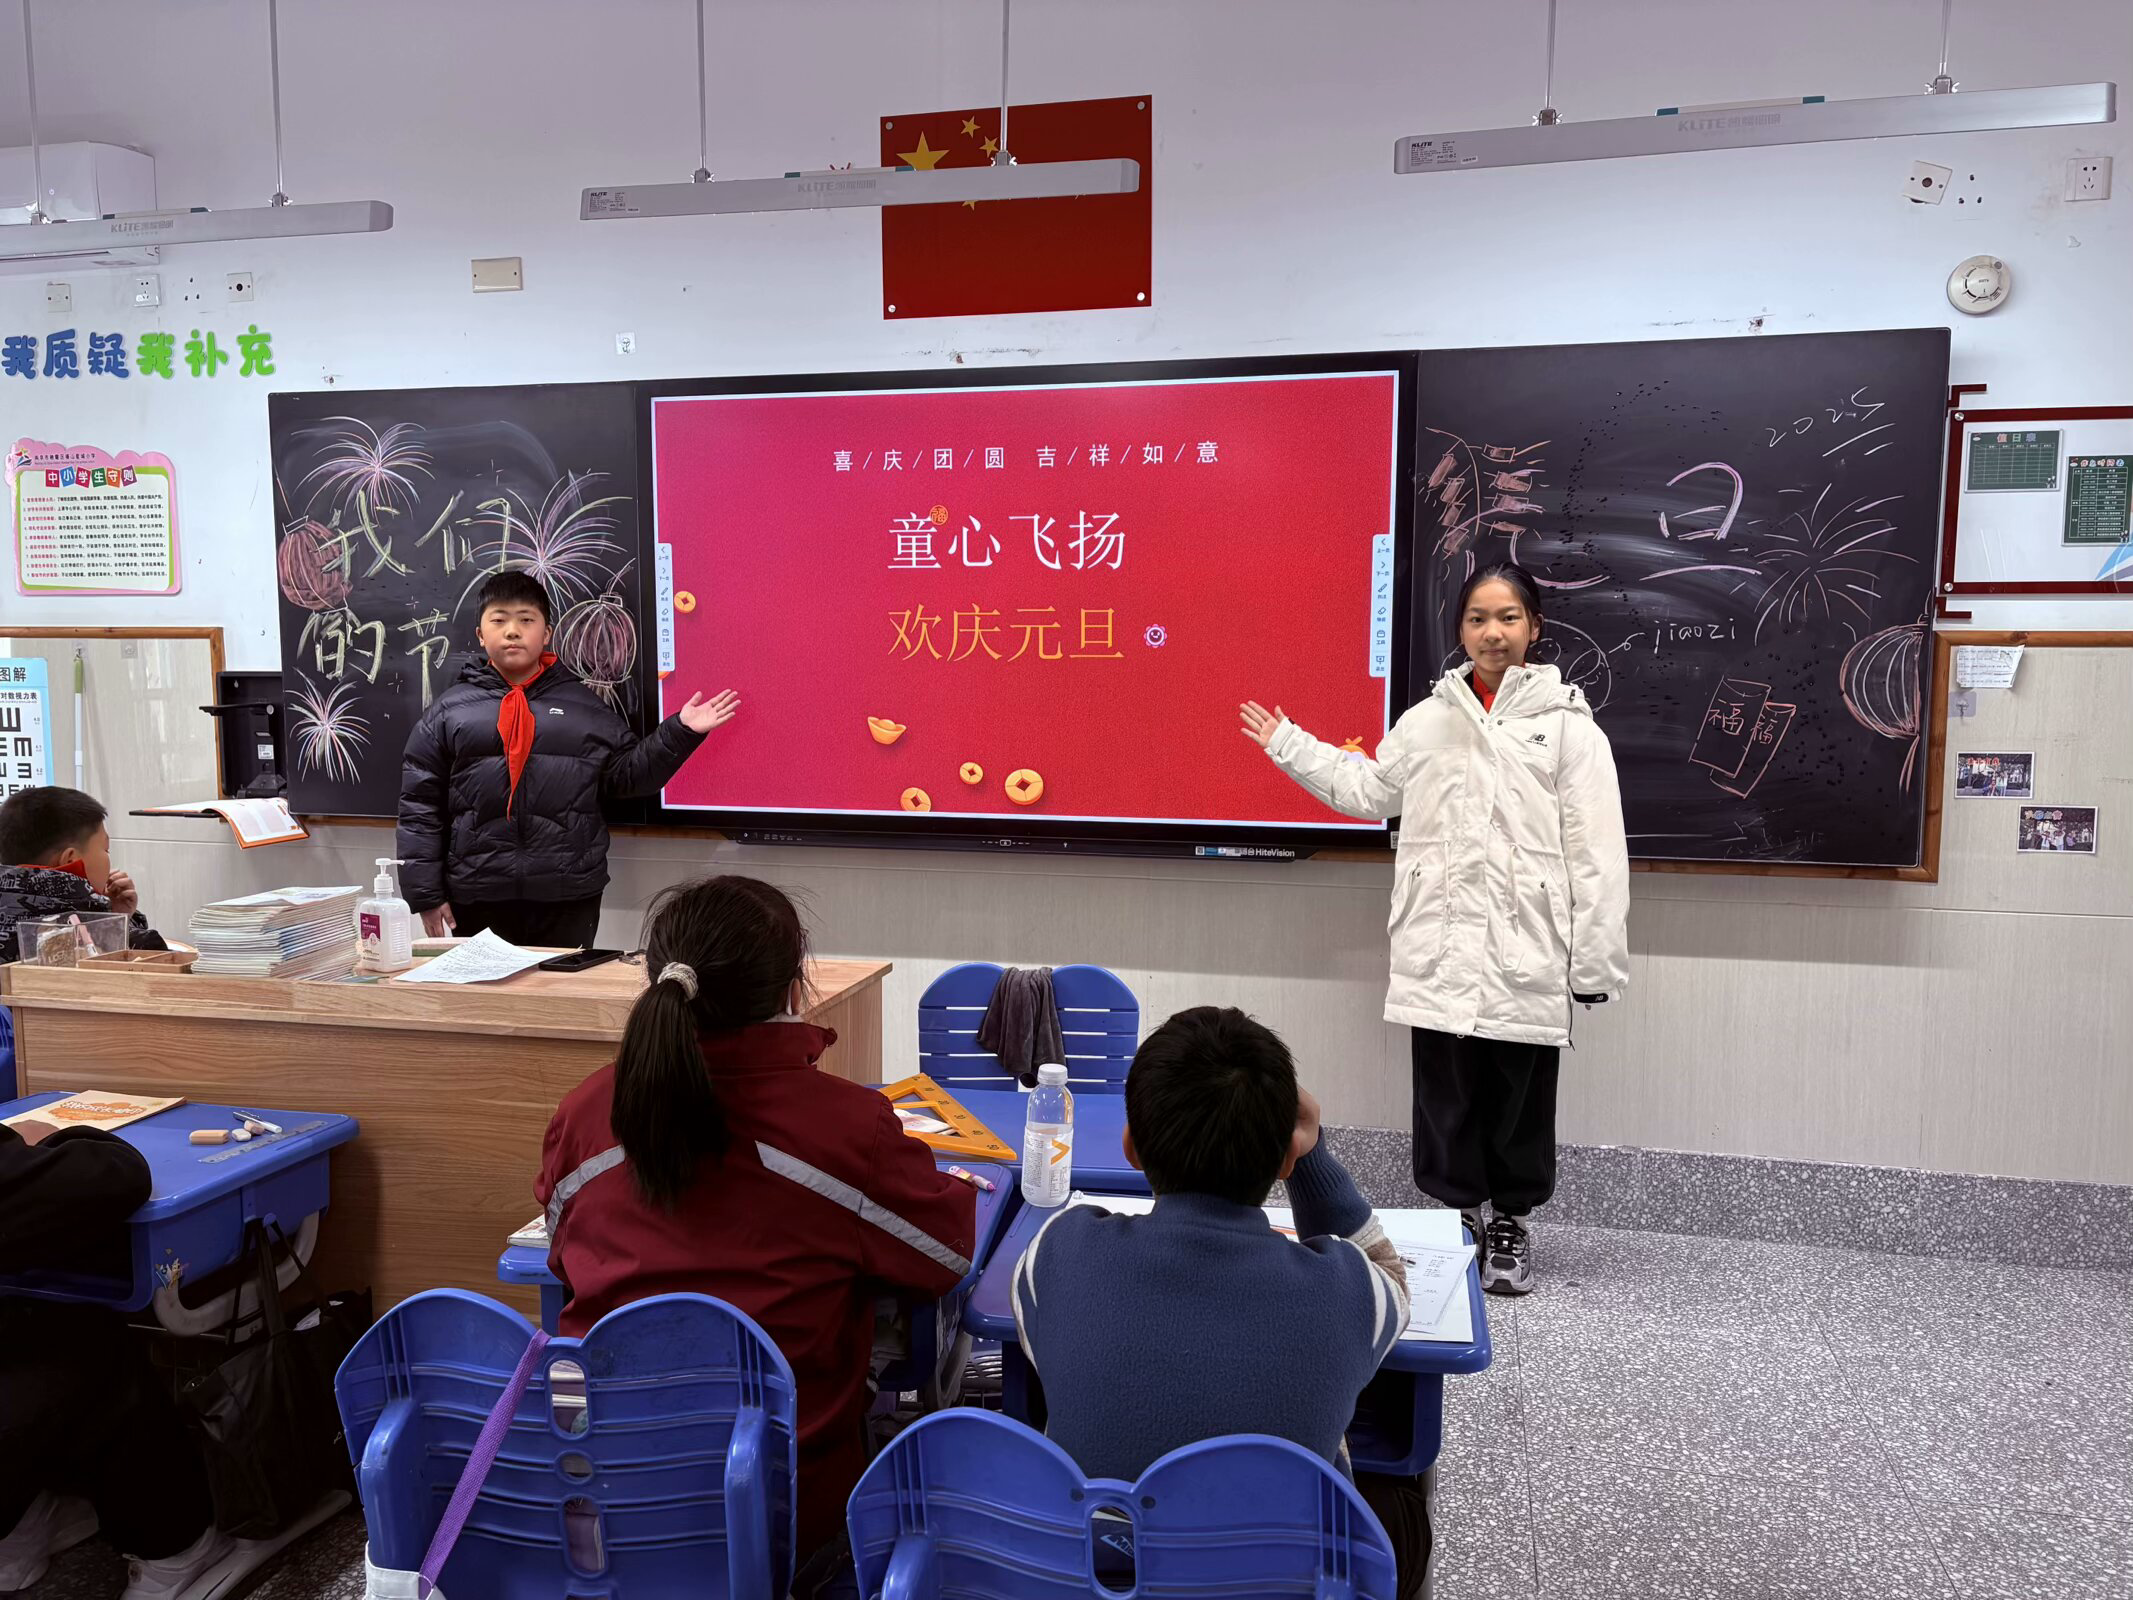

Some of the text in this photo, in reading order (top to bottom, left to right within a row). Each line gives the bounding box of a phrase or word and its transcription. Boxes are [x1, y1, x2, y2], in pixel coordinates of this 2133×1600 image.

[47, 470, 135, 485] 中小学生守则
[887, 509, 1126, 570] 童心飞扬
[887, 603, 1125, 662] 欢庆元旦
[1256, 848, 1295, 857] HiteVision
